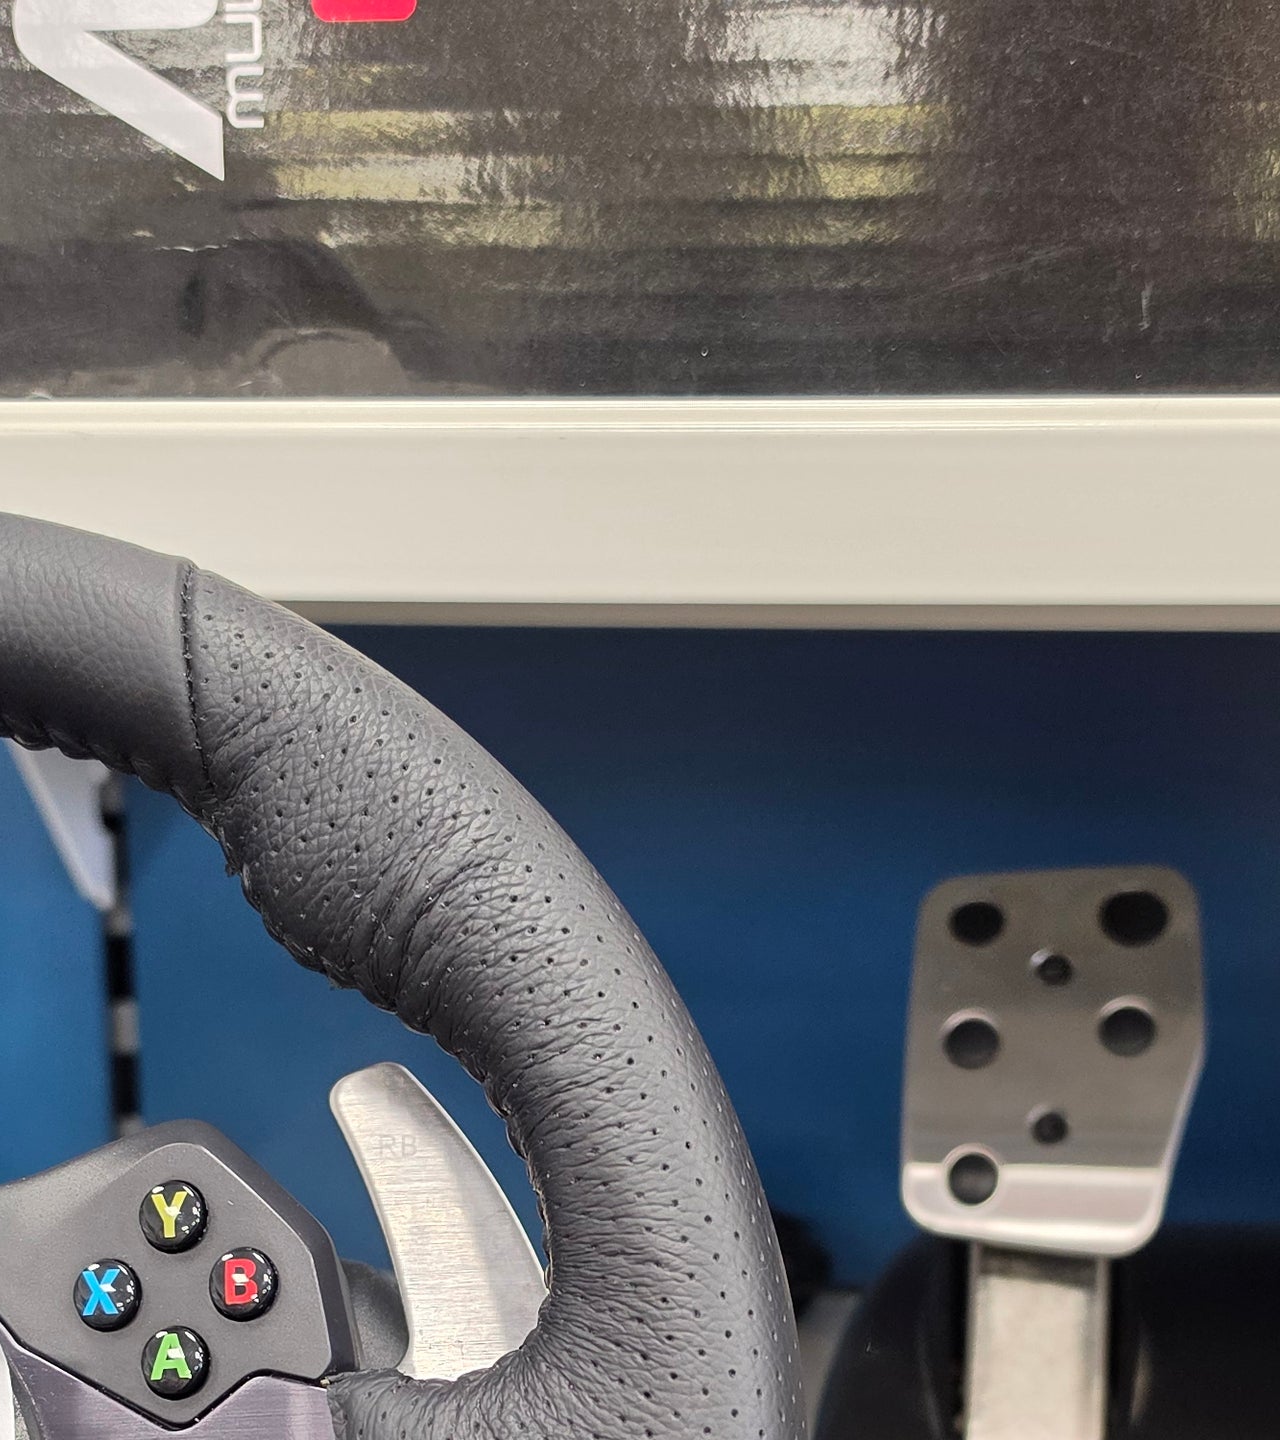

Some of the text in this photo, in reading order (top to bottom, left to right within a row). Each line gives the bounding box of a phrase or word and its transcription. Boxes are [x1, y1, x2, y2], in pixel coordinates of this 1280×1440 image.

[377, 1134, 419, 1158] RB
[151, 1191, 188, 1238] Y
[82, 1268, 121, 1316] X
[223, 1258, 258, 1305] B
[150, 1333, 192, 1381] A
